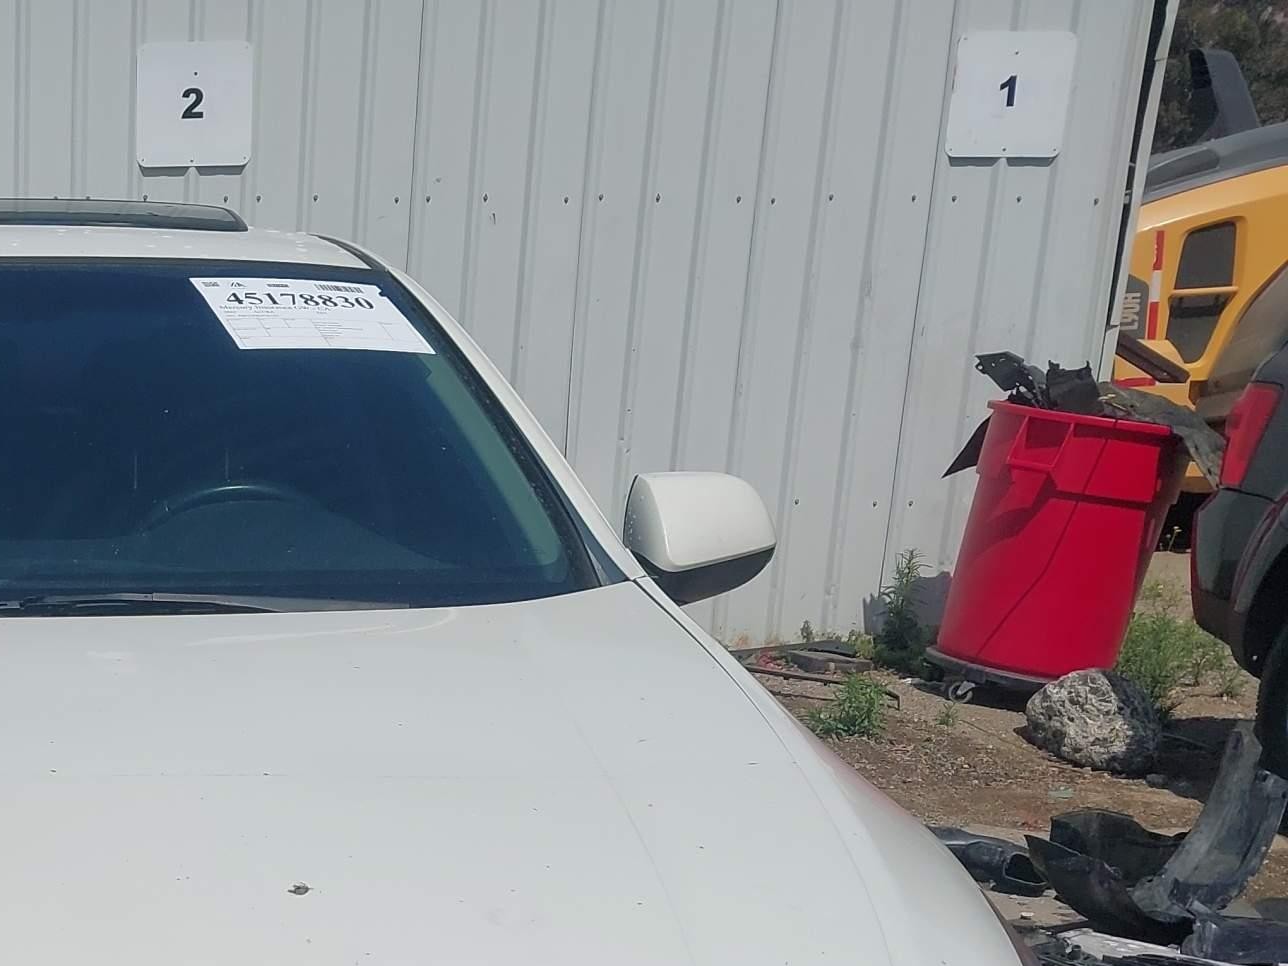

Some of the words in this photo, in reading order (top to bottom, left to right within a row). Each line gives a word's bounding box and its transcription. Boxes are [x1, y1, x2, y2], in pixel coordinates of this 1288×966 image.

[181, 87, 204, 120] 2
[999, 75, 1017, 108] 1
[226, 292, 374, 310] 45178830
